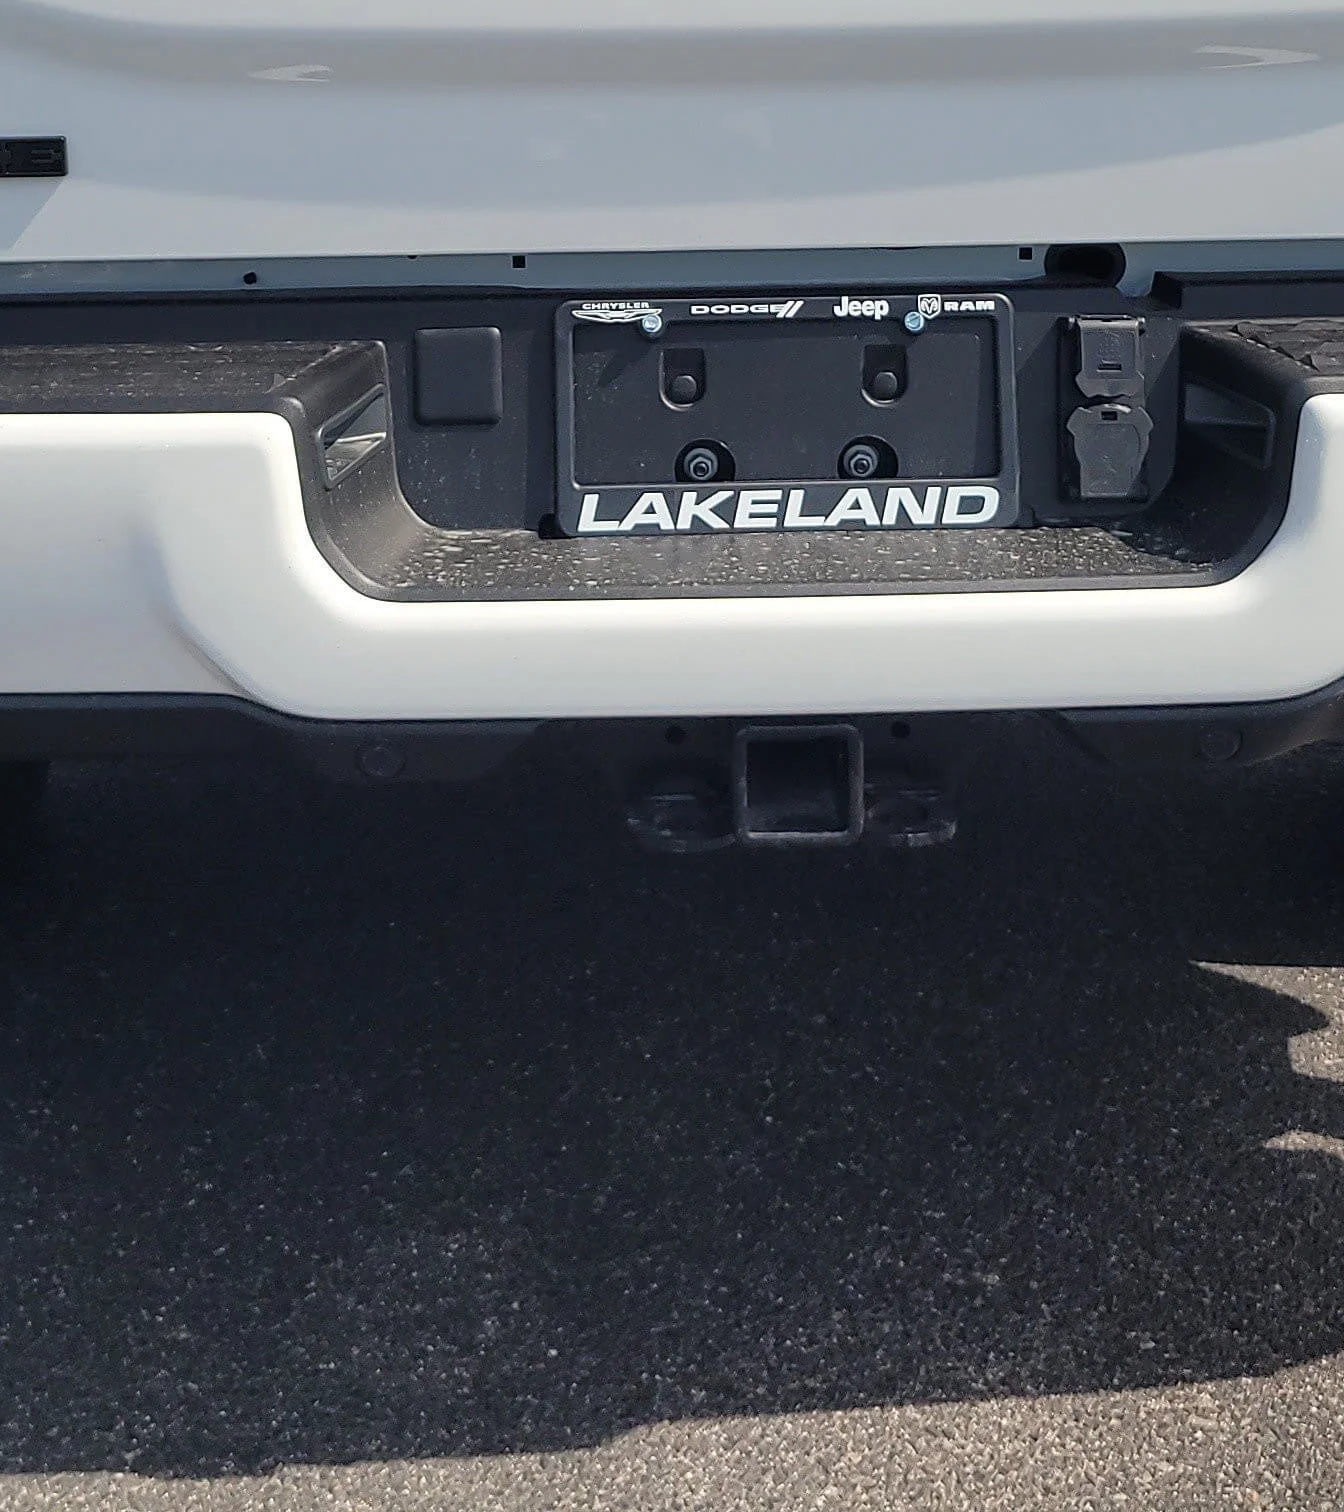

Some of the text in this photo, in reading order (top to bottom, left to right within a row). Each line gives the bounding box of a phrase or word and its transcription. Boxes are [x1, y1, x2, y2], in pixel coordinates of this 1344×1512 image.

[581, 301, 651, 311] CHRYSLER
[690, 302, 782, 316] DODGE
[833, 296, 889, 320] Jeep
[943, 300, 995, 312] RAM
[577, 485, 1000, 532] LAKELAND
